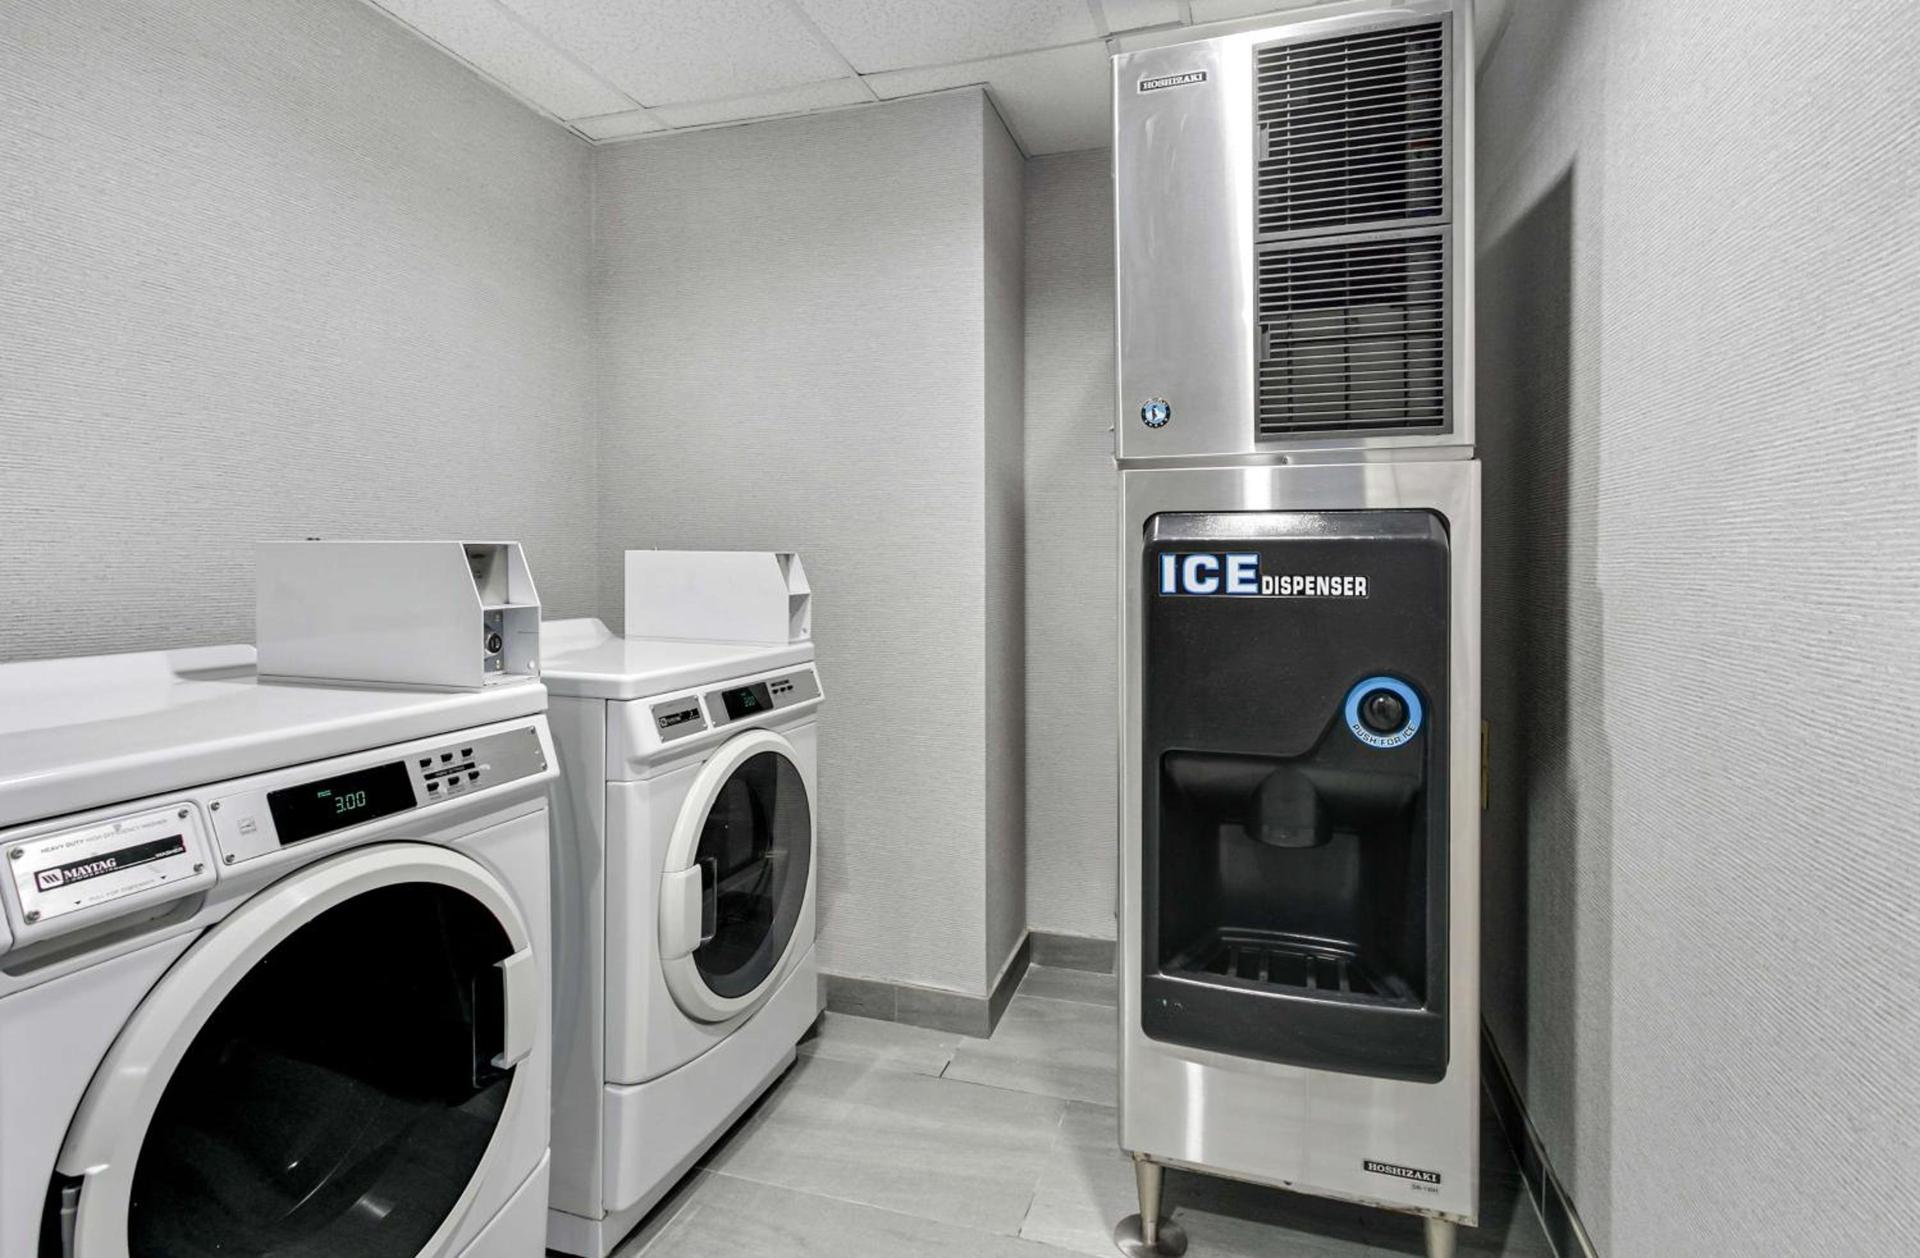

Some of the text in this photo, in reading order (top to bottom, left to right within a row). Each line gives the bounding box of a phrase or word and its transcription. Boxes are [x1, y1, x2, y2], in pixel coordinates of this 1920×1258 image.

[1161, 553, 1367, 597] ICE DISPENSER
[1353, 723, 1416, 746] PUSH FOR ICE
[334, 790, 366, 814] 3.00
[64, 857, 117, 879] MAYTAG
[1367, 1162, 1437, 1182] HOSHIZAKI
